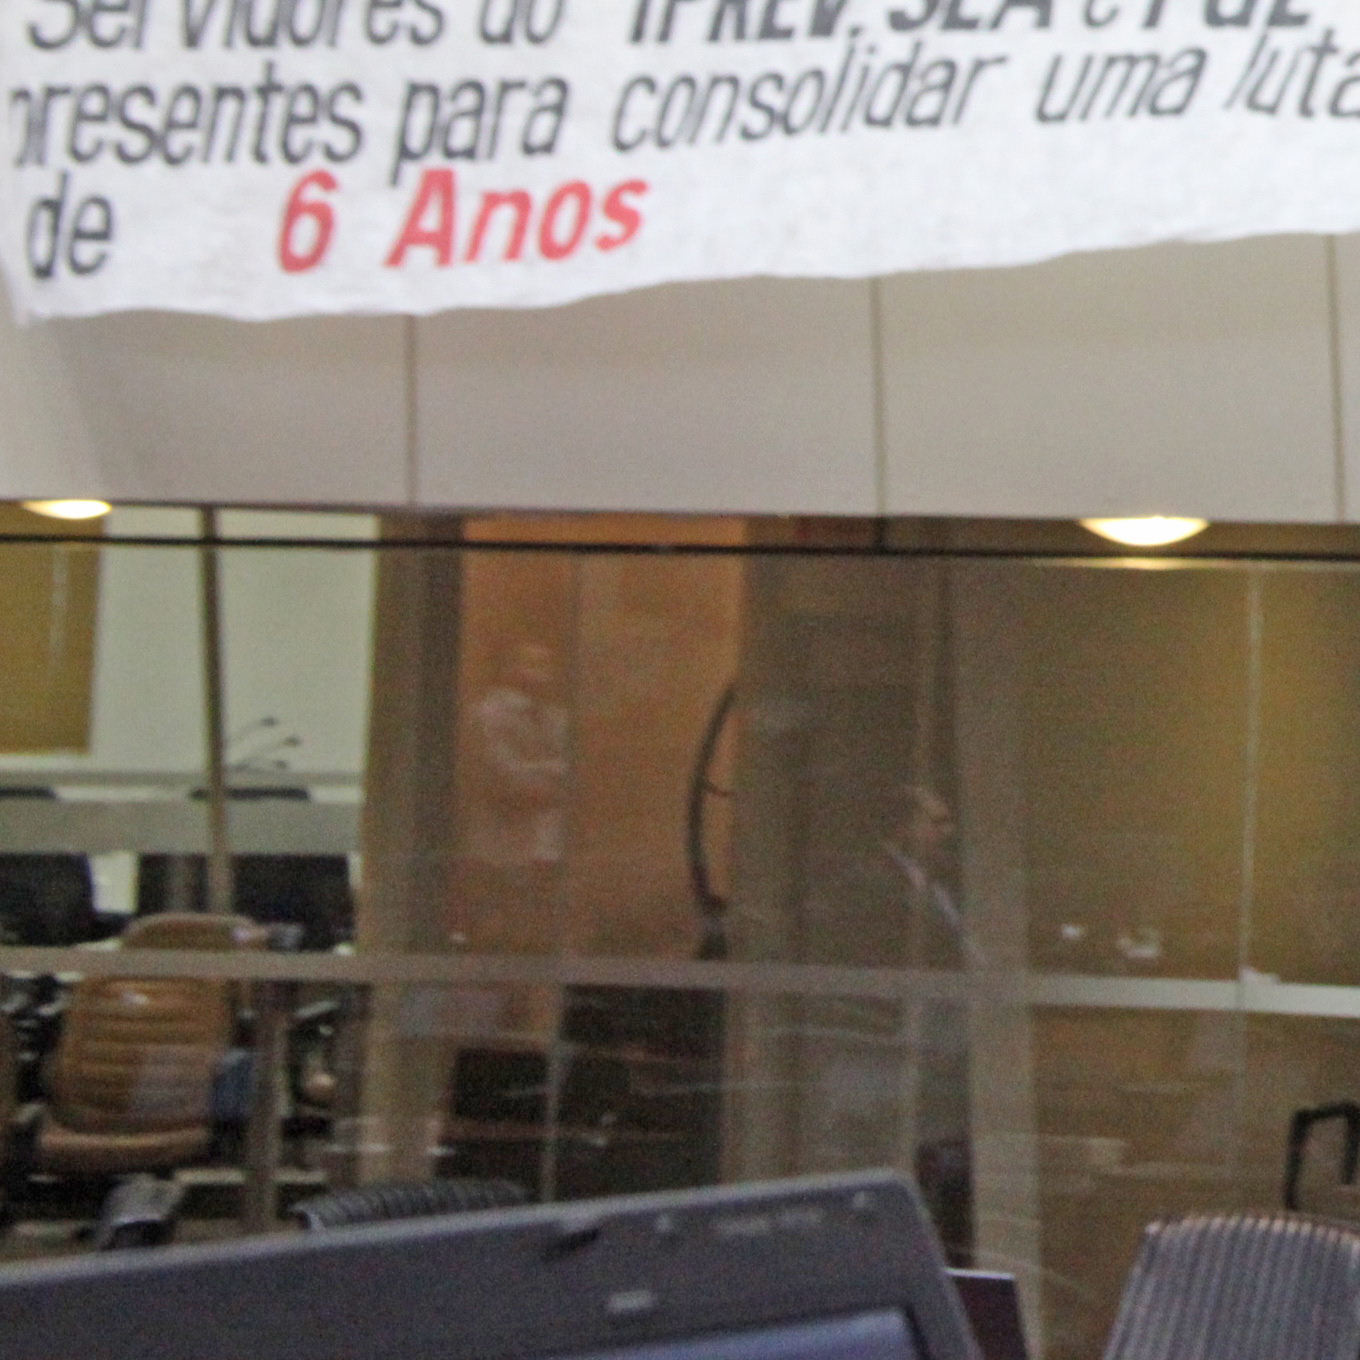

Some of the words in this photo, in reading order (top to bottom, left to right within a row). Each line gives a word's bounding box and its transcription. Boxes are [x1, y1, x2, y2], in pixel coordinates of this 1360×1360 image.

[390, 73, 569, 186] para
[612, 40, 1006, 151] consolidar
[1035, 45, 1207, 123] uma
[27, 172, 114, 279] de
[277, 171, 341, 273] 6
[384, 169, 649, 269] Anos
